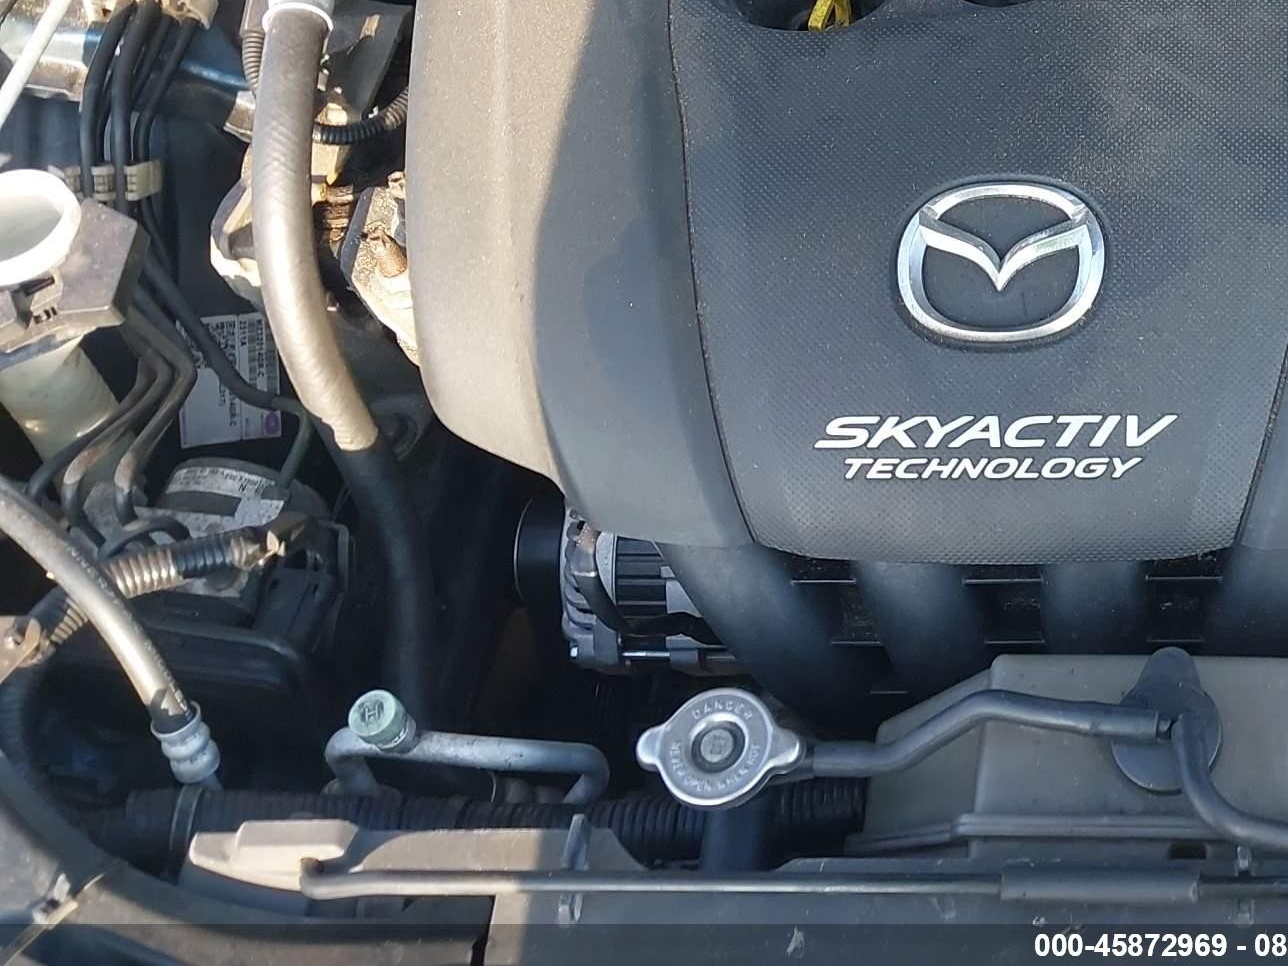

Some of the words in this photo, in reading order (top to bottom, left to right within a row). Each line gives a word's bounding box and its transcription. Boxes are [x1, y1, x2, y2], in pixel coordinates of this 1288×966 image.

[814, 415, 1178, 449] SKYACTIV
[844, 457, 1143, 480] TECHNOLOGY
[692, 700, 753, 719] DANGER
